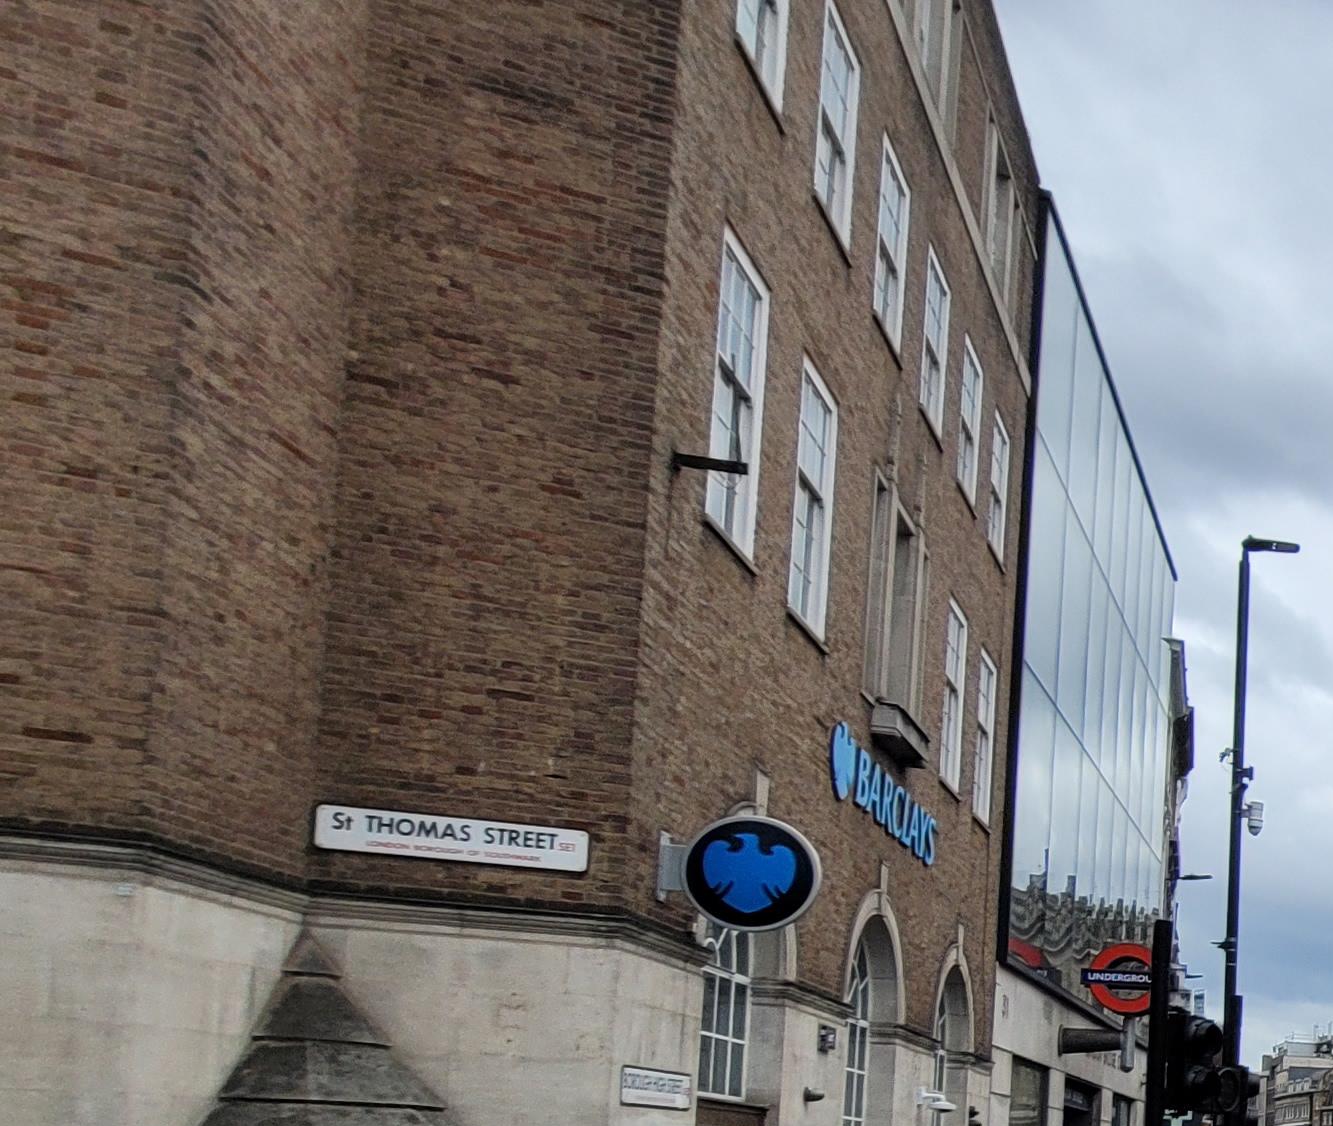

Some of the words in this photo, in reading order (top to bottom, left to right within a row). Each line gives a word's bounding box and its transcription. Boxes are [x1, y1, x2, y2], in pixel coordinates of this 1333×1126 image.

[855, 748, 937, 866] BARCLAYS
[331, 812, 354, 831] St
[365, 815, 471, 842] THOMAS
[483, 827, 559, 850] STREET
[366, 840, 410, 850] LONDON
[467, 849, 480, 857] OF
[1088, 972, 1152, 983] UNDERGROU
